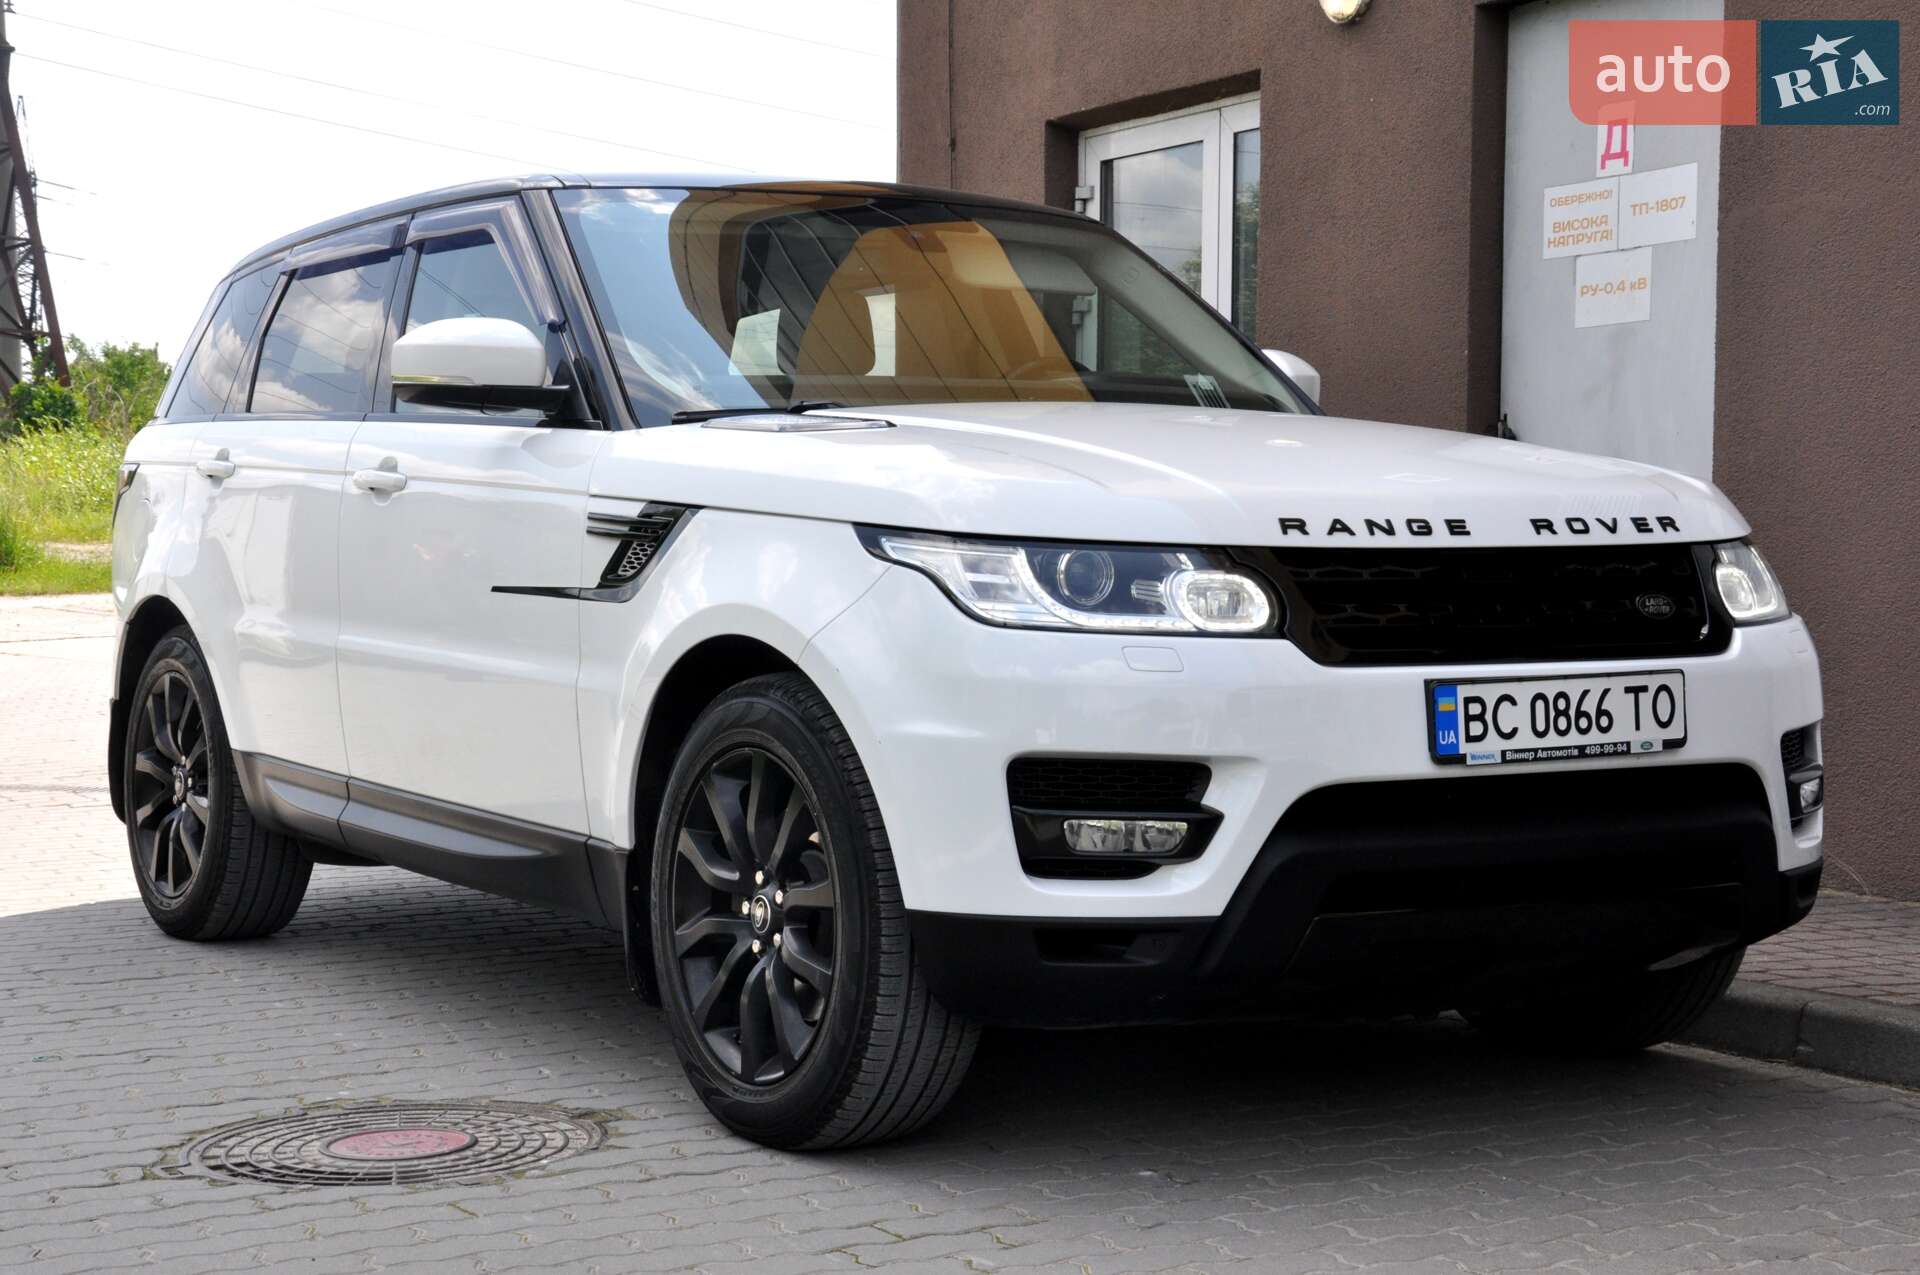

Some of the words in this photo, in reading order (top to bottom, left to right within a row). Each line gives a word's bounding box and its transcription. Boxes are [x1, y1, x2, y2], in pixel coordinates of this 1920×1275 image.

[1600, 118, 1629, 170] Д
[1550, 189, 1613, 208] ОБЕРЕЖНО!
[1630, 196, 1686, 216] ТП-1807
[1552, 215, 1609, 233] ВИСОКА
[1547, 229, 1613, 248] НАПРУГА!
[1278, 517, 1472, 536] RANGE
[1529, 516, 1681, 536] ROVER
[1463, 693, 1519, 743] BC
[1530, 687, 1614, 739] 0866
[1439, 730, 1457, 745] UA
[1506, 750, 1535, 761] Віннер
[1537, 747, 1579, 759] Автомотів
[1584, 743, 1628, 755] 499-99-94
